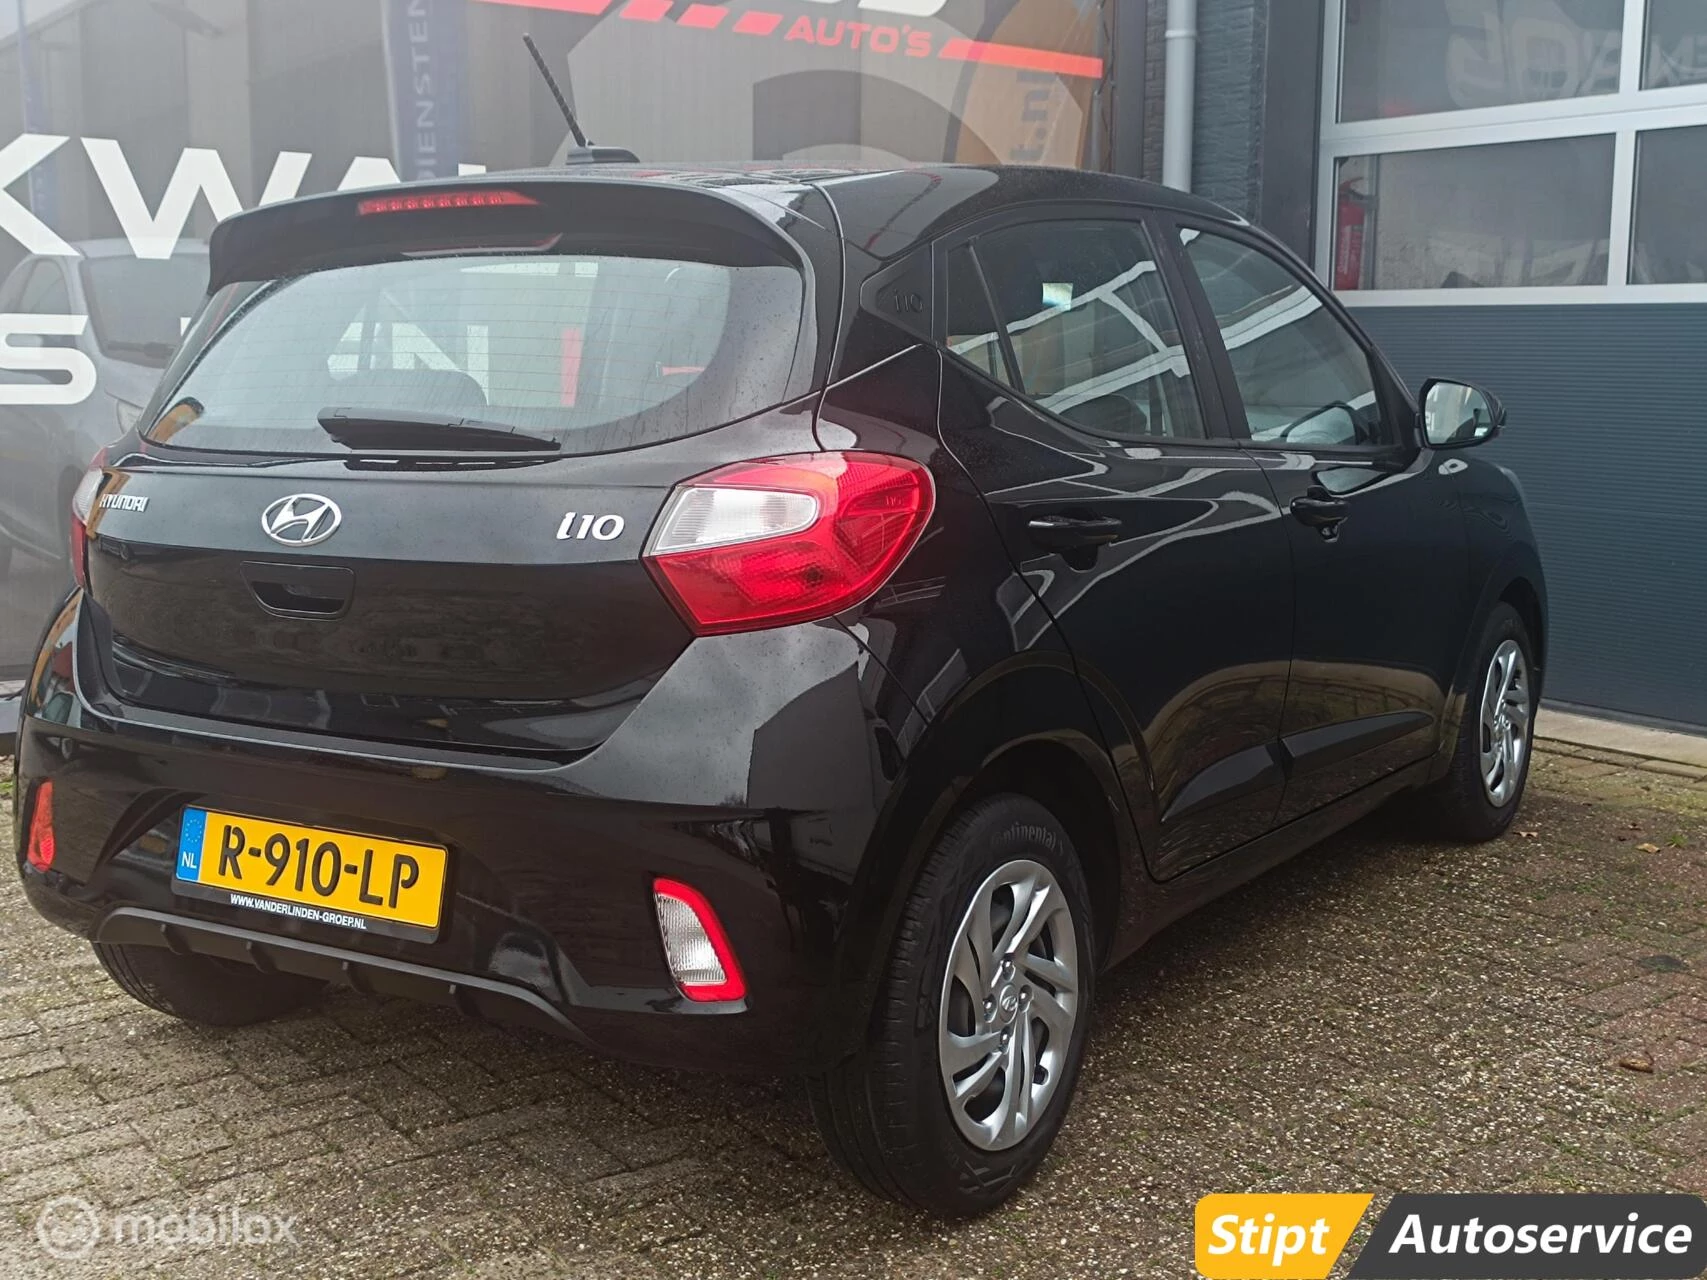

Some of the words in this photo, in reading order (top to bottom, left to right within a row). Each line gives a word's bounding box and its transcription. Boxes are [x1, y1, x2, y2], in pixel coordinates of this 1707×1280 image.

[784, 15, 932, 58] AUTO'S
[99, 494, 149, 512] HYUNDAI
[181, 851, 198, 869] NL
[218, 825, 420, 909] R-910-LP
[230, 894, 367, 930] WWW.VANDERLINDEN-GROEP.NL
